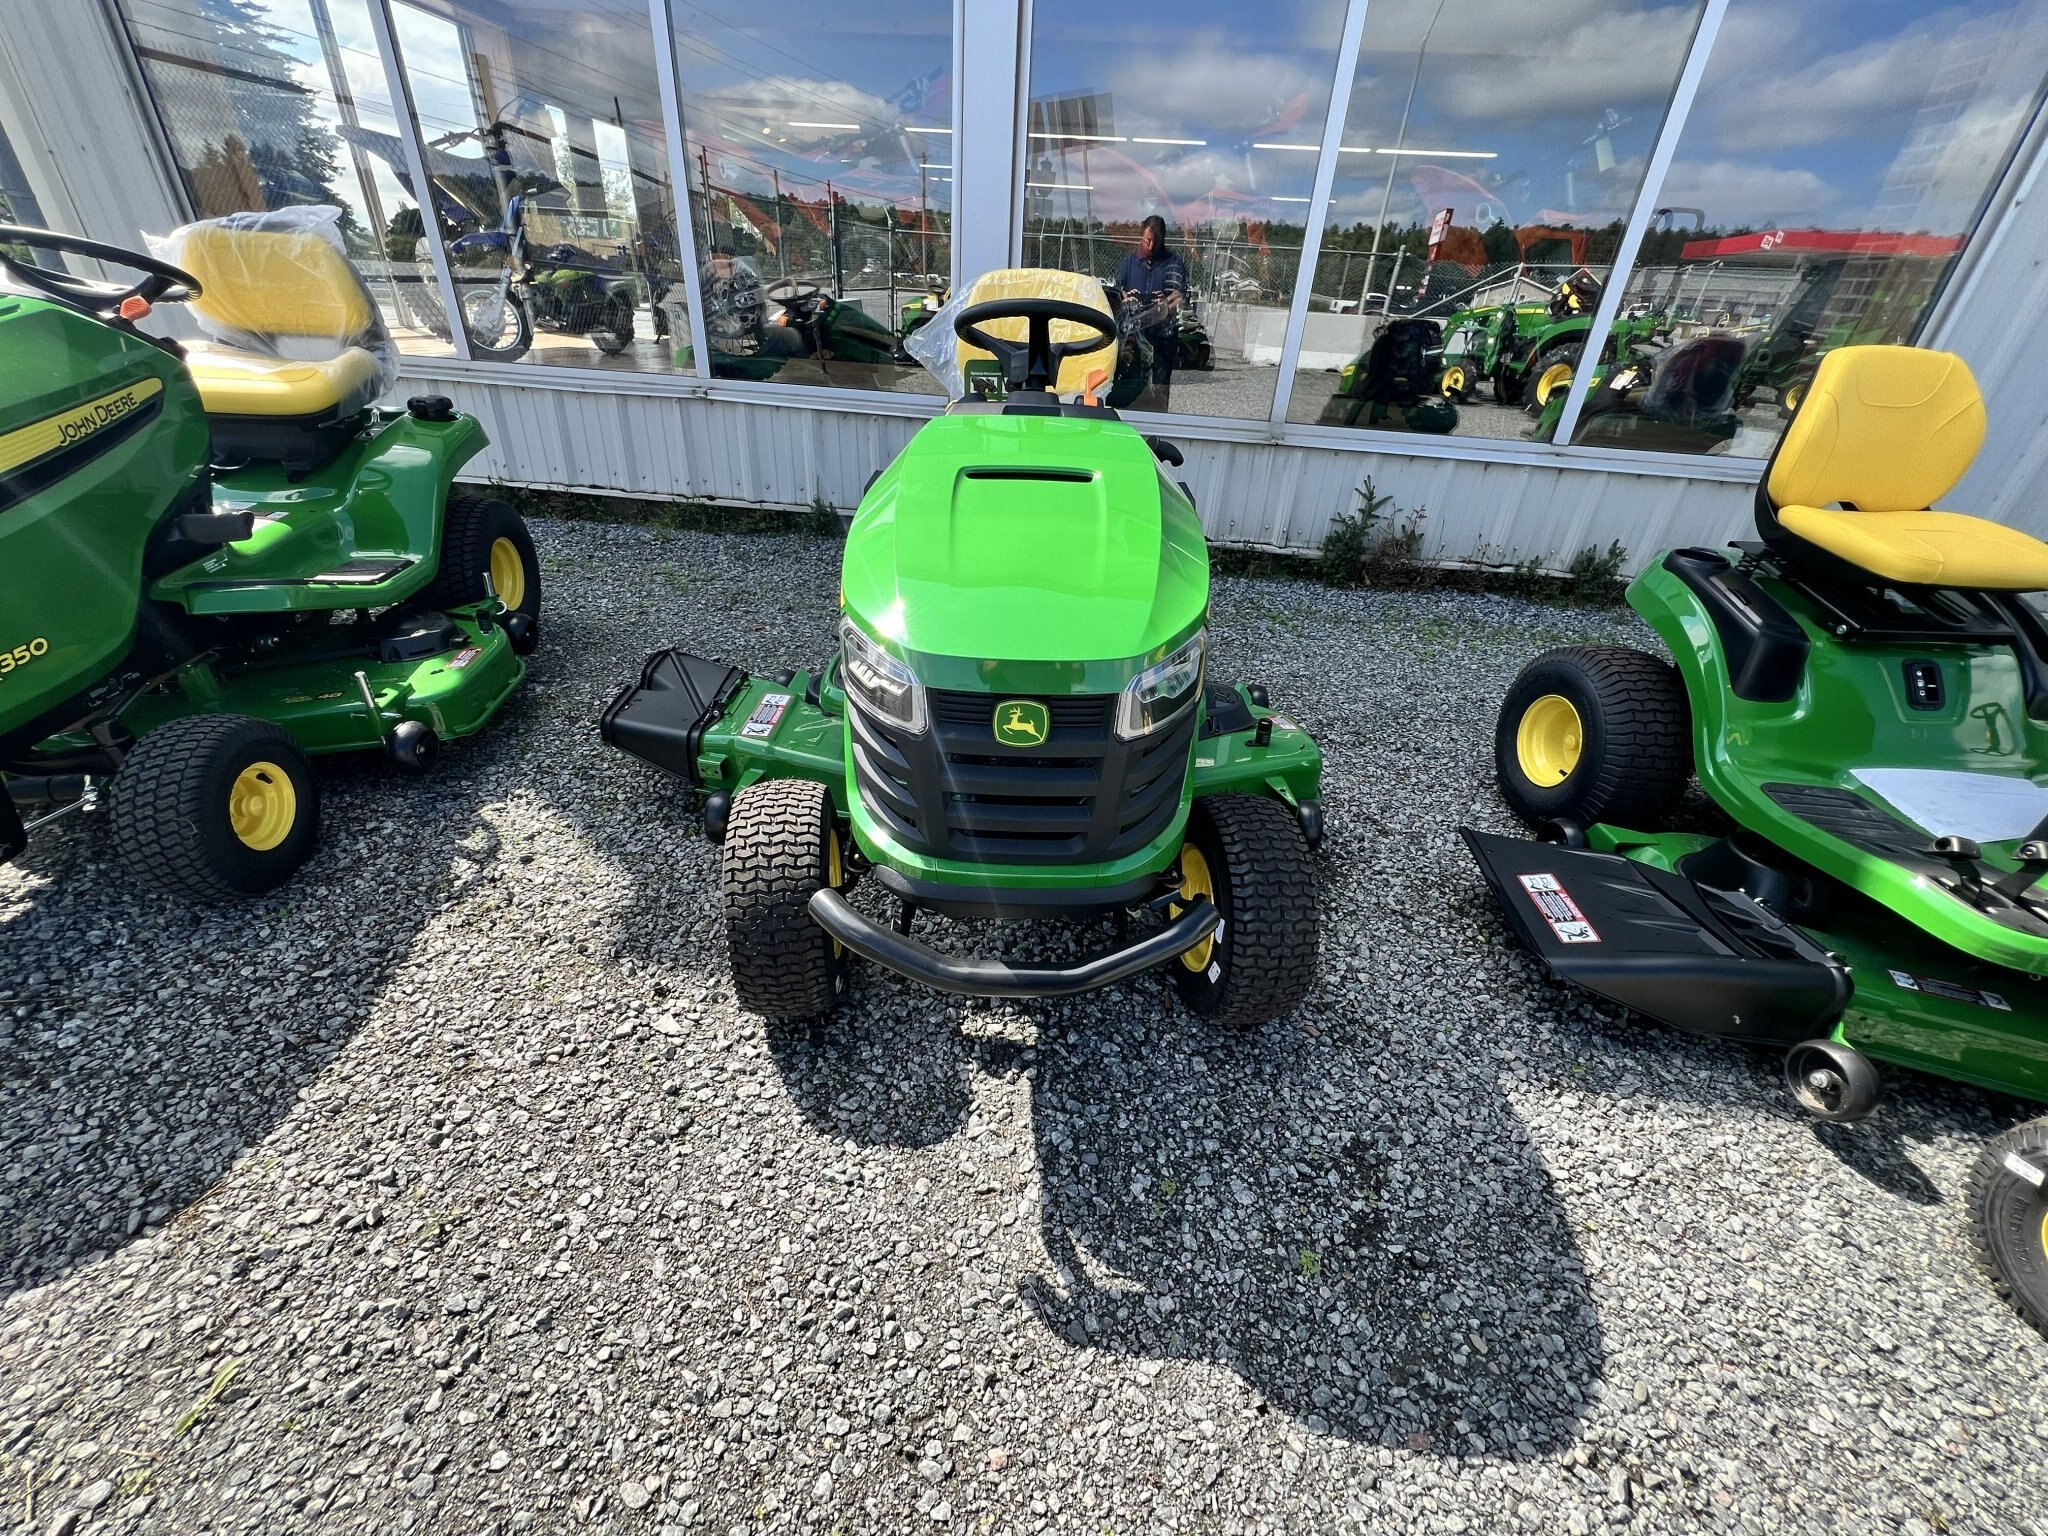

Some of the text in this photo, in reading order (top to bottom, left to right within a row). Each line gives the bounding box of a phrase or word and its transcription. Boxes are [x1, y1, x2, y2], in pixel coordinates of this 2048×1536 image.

[58, 392, 137, 444] JOHN DEERE
[0, 637, 48, 680] 350
